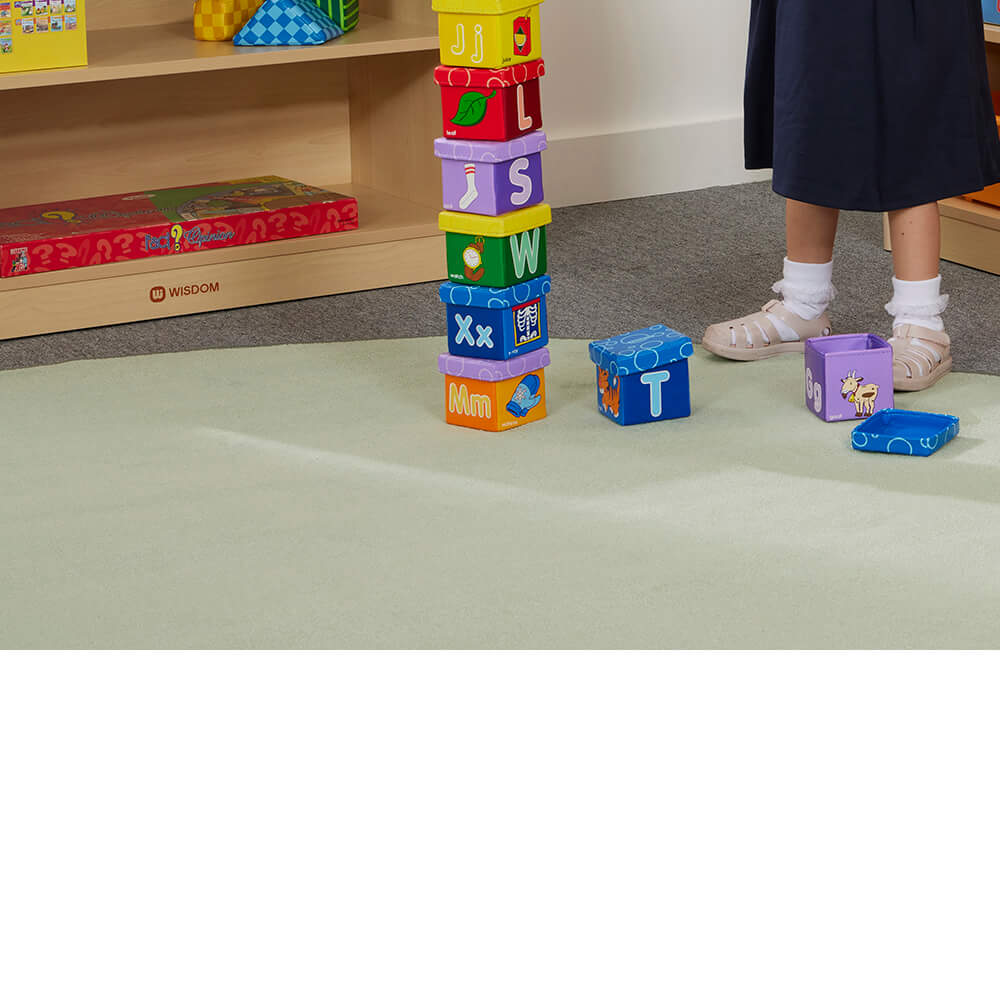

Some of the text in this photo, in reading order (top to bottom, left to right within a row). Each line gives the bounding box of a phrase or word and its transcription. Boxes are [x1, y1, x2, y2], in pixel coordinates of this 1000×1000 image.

[451, 23, 484, 64] Jj
[516, 84, 533, 131] L
[509, 157, 533, 206] S
[509, 227, 540, 280] W
[169, 282, 220, 298] WISDOM
[454, 313, 494, 349] Xx
[448, 382, 491, 419] Mm
[640, 369, 671, 418] T
